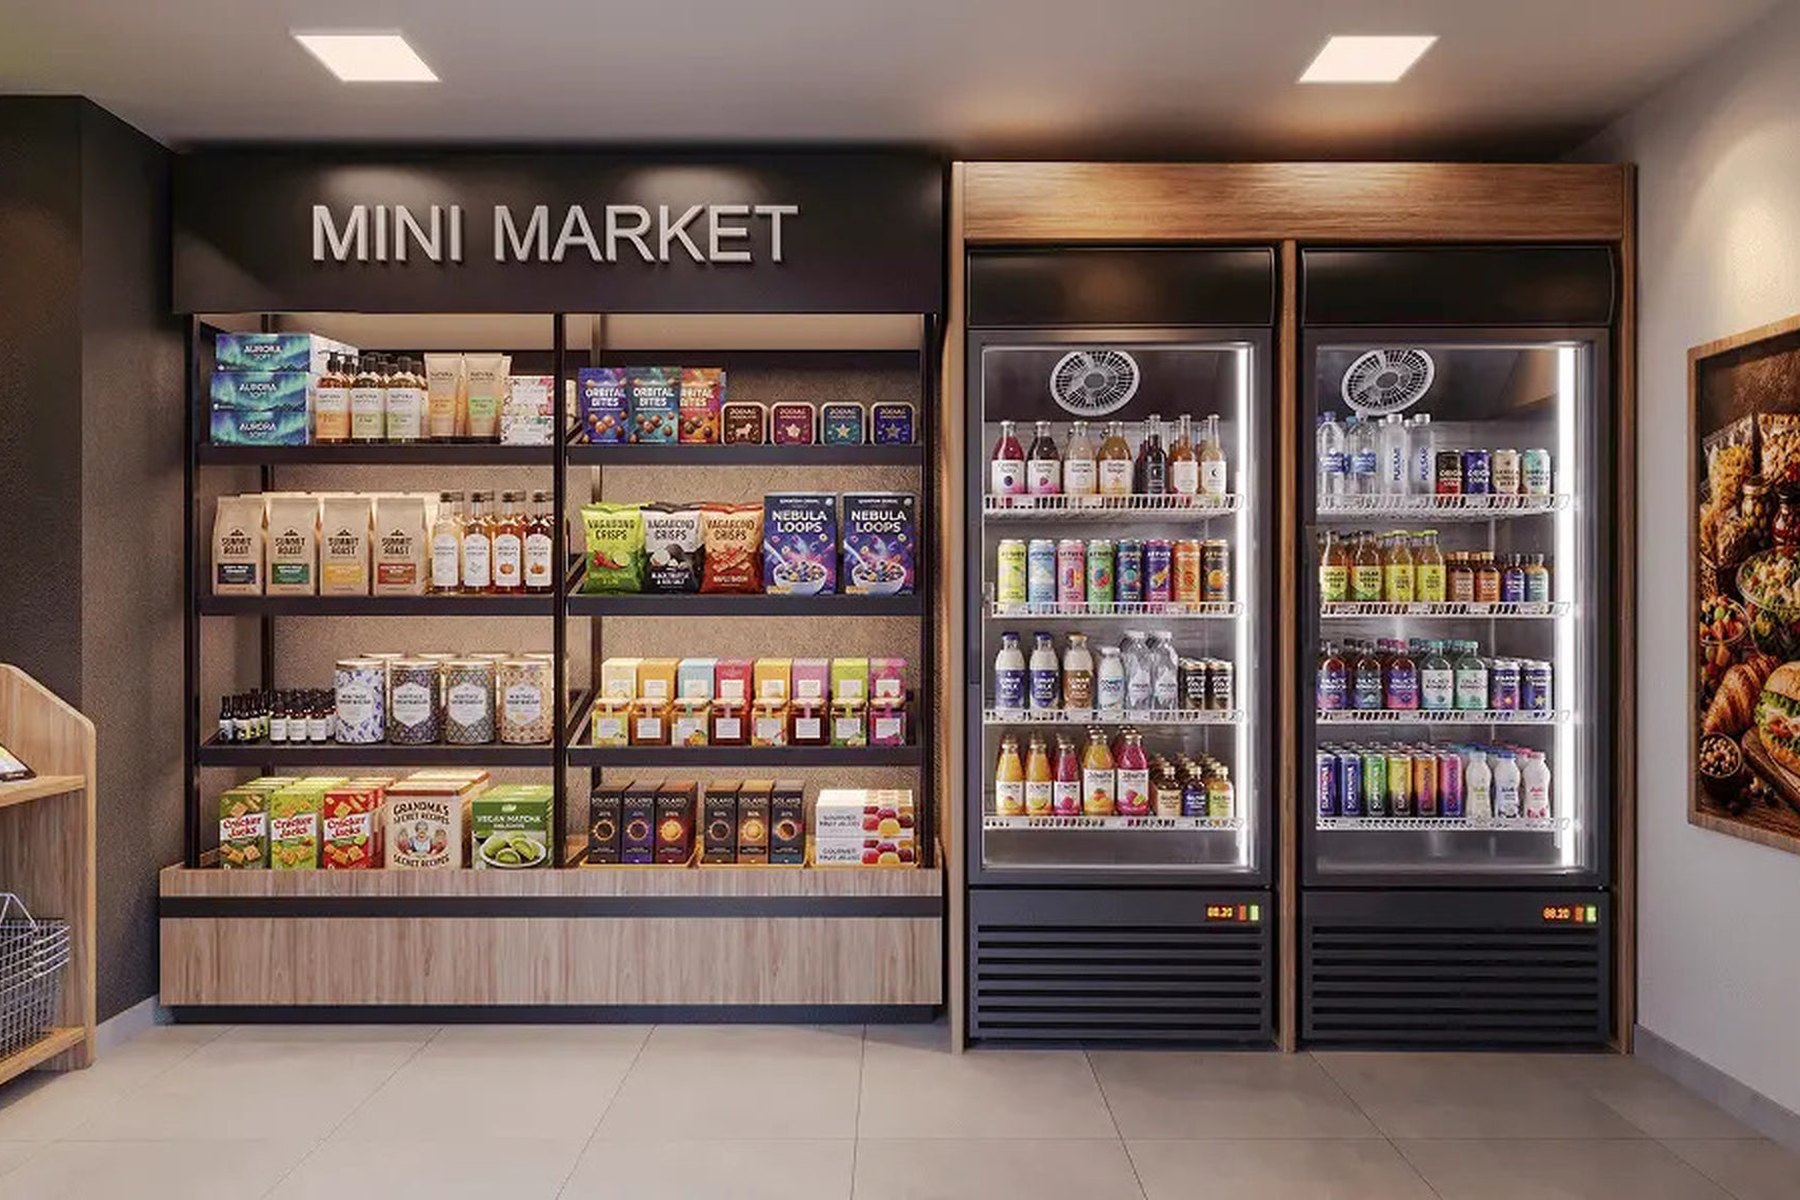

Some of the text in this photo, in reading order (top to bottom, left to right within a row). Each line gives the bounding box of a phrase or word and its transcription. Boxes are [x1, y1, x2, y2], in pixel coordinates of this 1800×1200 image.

[312, 205, 799, 264] MINI MARKET
[585, 387, 626, 398] ORBITAL
[633, 387, 675, 397] ORBITAL
[772, 510, 828, 521] NEBULA
[851, 510, 907, 521] NEBULA
[777, 521, 823, 533] LOOPS
[855, 521, 901, 533] LOOPS
[595, 530, 628, 540] CRISPS
[654, 530, 688, 540] CRISPS
[714, 530, 748, 540] CRISPS
[393, 801, 450, 817] GRANDMA'S
[476, 815, 542, 824] VEGAN MATCHA
